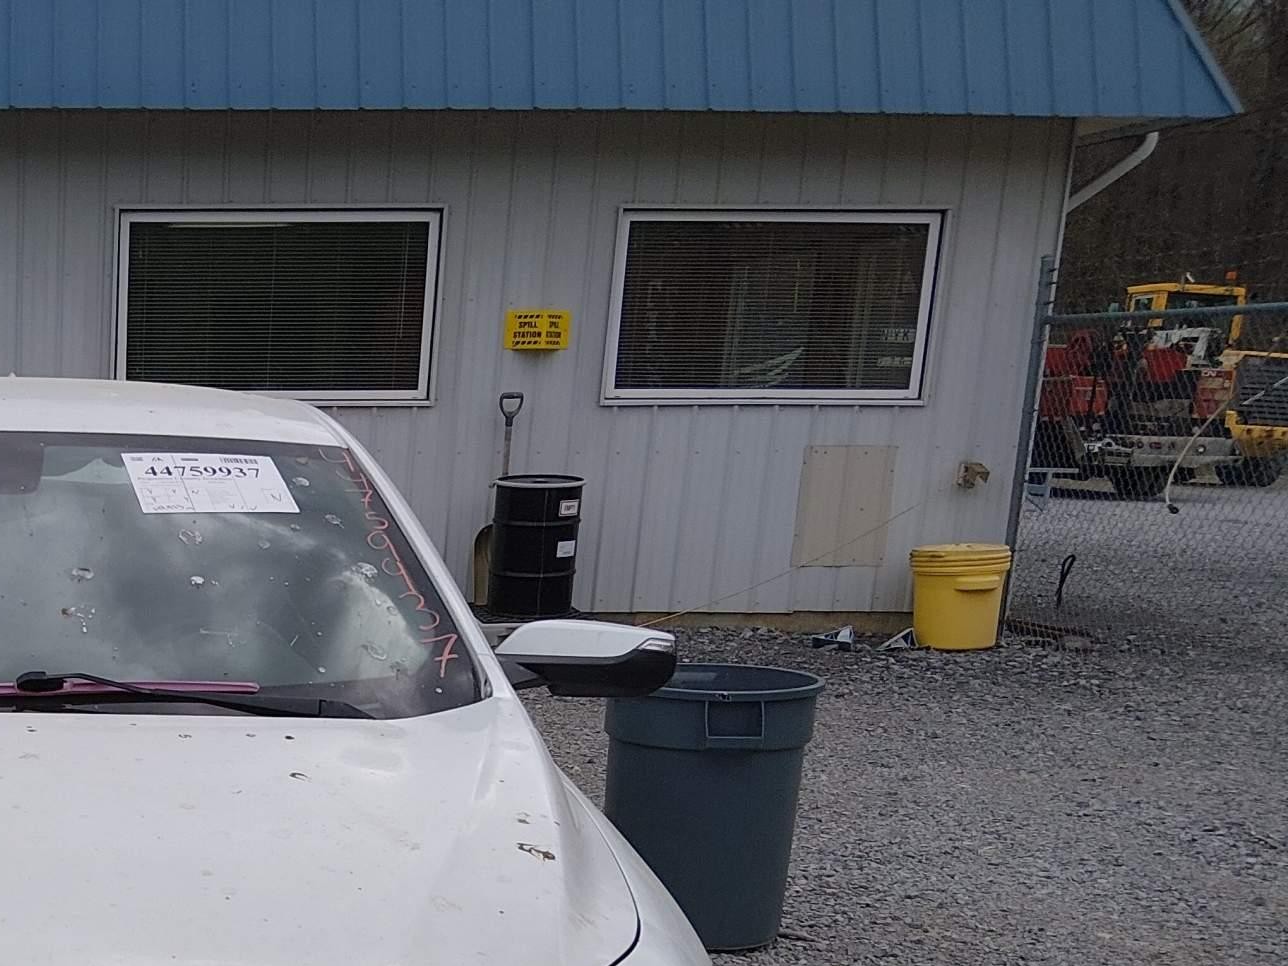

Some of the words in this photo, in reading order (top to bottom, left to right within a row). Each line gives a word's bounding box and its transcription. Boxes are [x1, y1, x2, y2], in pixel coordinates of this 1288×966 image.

[518, 321, 538, 329] SPILL
[513, 331, 542, 339] STATION
[144, 465, 260, 479] 44759937
